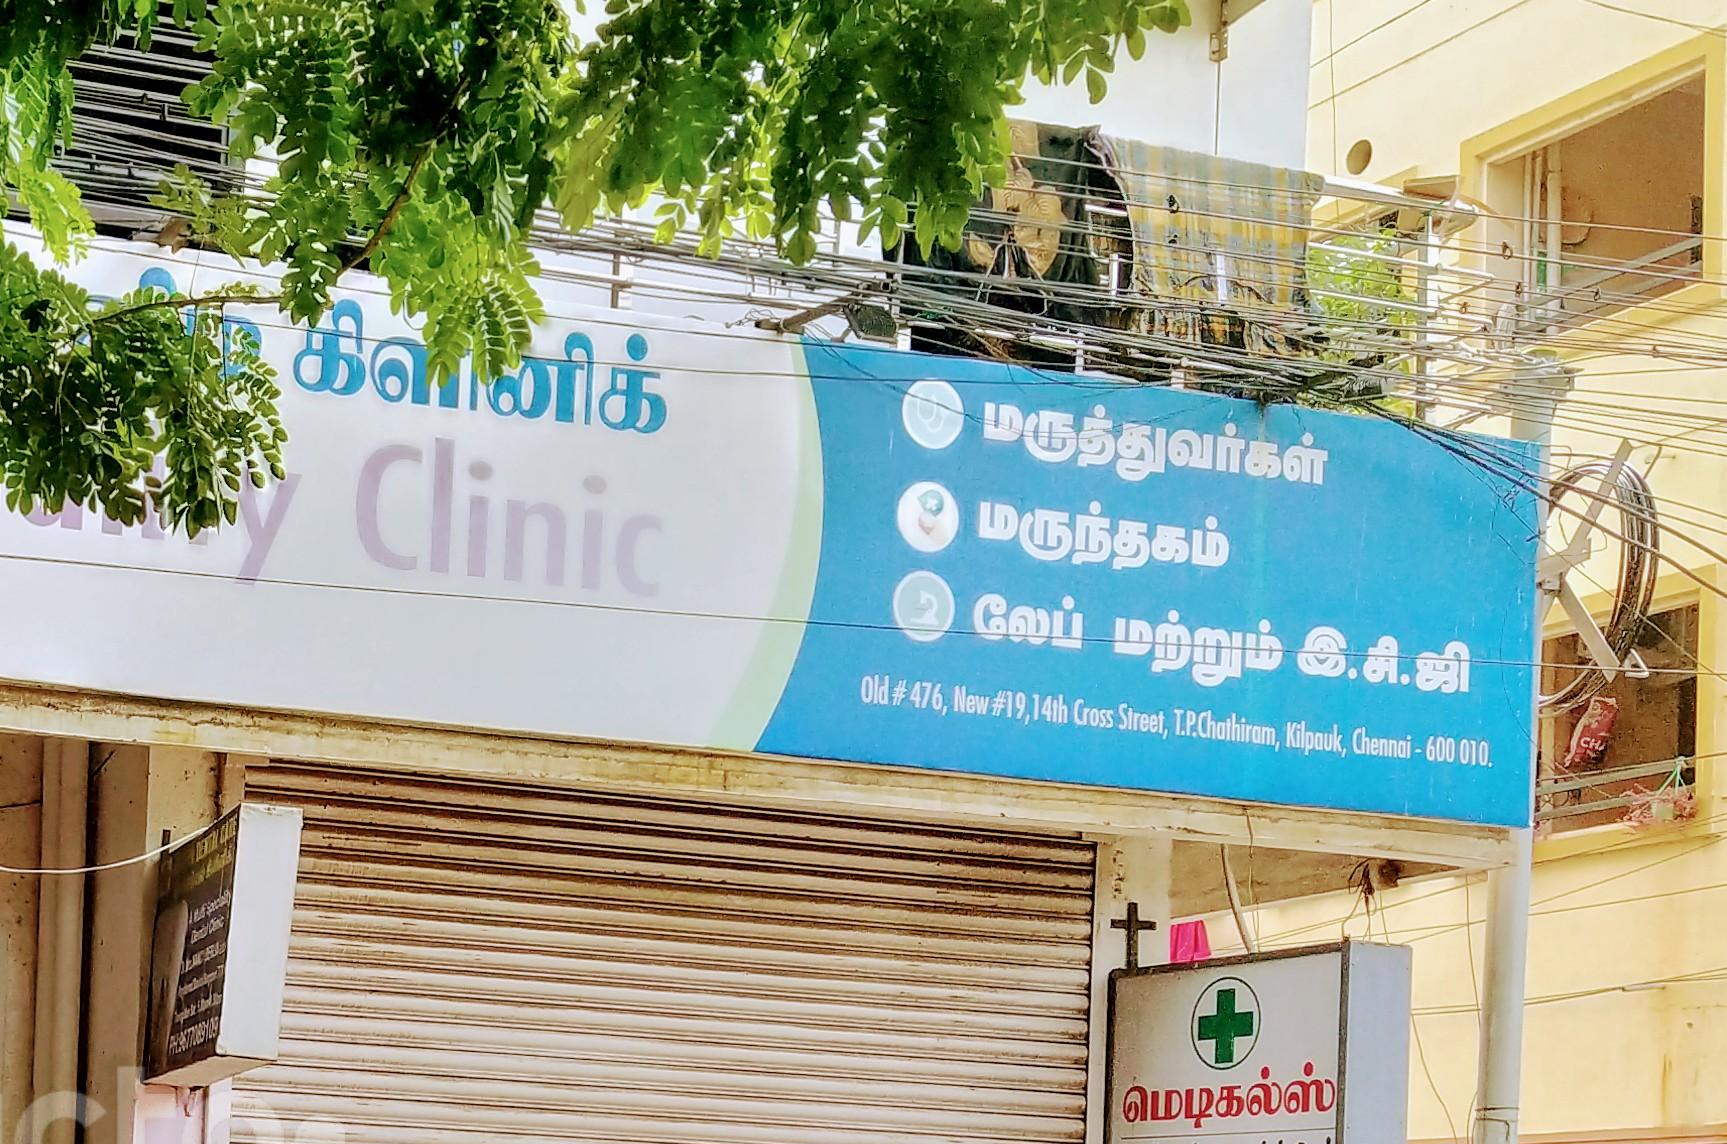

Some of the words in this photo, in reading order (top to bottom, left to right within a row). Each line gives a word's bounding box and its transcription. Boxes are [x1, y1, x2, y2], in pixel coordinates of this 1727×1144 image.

[983, 402, 1328, 485] மருத்துவர்கள்
[356, 437, 663, 598] Clinic
[978, 500, 1230, 570] மருந்தகம்
[973, 593, 1084, 649] லேப்
[1114, 609, 1284, 687] மற்றும்
[1297, 626, 1470, 693] இ.சி.ஜி
[861, 675, 889, 705] Old
[910, 681, 948, 716] 476,
[953, 685, 988, 715] New
[1073, 698, 1113, 728] Cross
[1119, 704, 1168, 739] Street,
[1174, 708, 1280, 752] T.P.Chathiram,
[1286, 721, 1346, 757] Kilpauk,
[1352, 727, 1411, 759] Chennai
[1426, 735, 1455, 763] 600
[1459, 739, 1492, 767] 010.
[1123, 1062, 1335, 1128] மெடிகல்ஸ்
